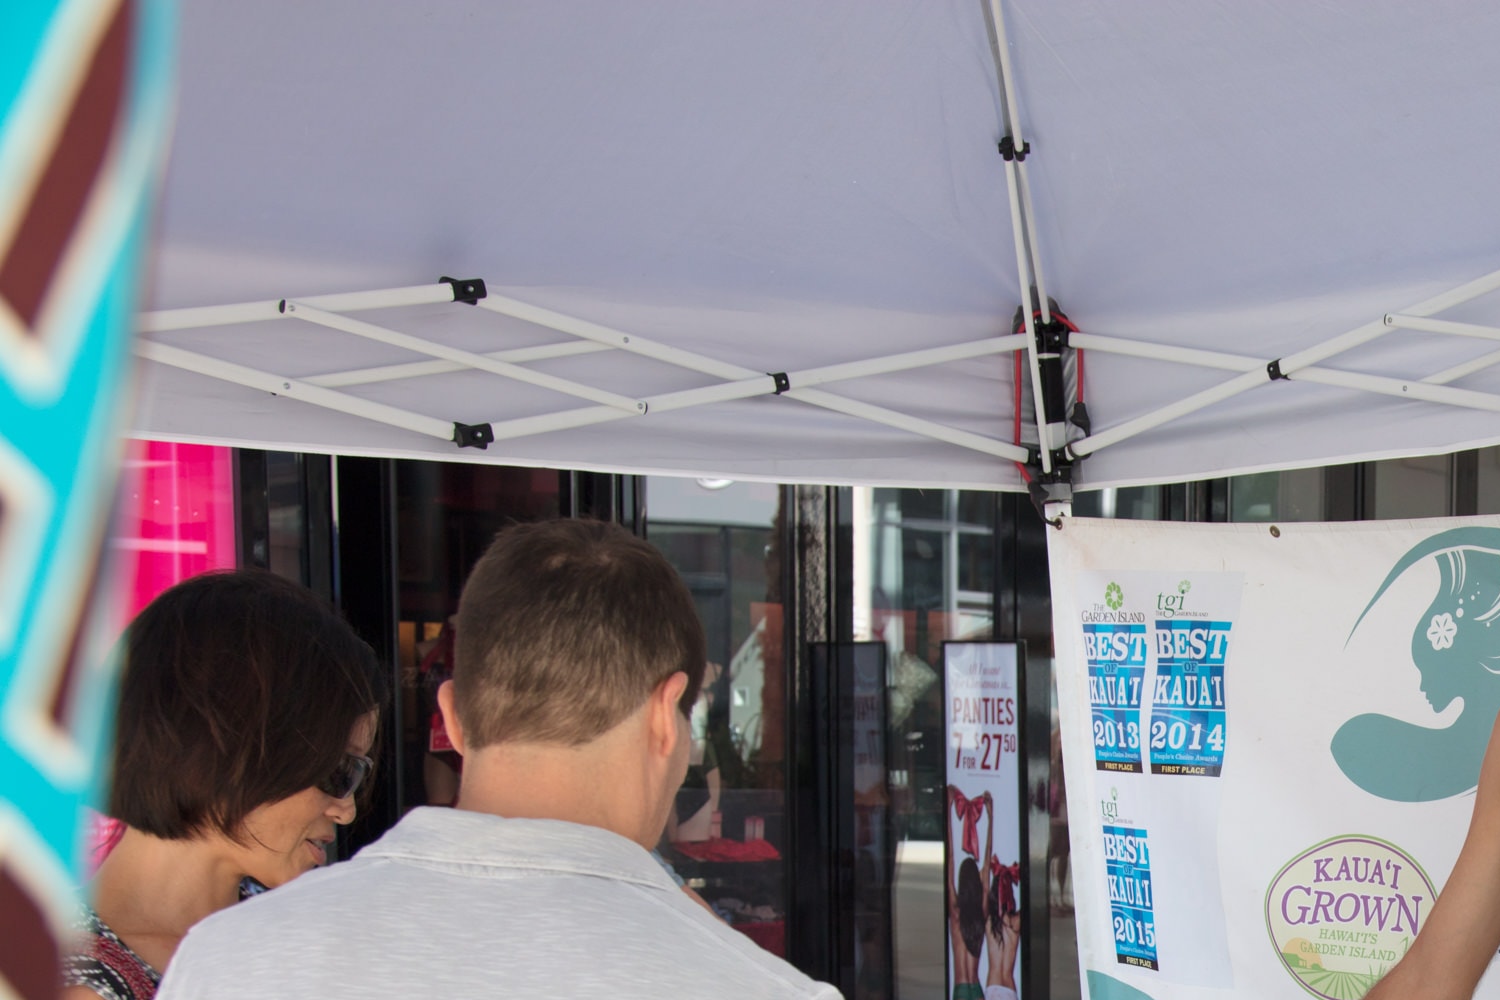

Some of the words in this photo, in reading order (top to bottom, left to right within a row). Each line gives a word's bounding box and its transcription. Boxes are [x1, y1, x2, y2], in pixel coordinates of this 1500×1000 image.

[1081, 610, 1117, 623] GARDEN
[1117, 612, 1145, 623] ISLAND
[1084, 631, 1148, 662] BEST
[1156, 628, 1229, 660] BEST
[1104, 663, 1117, 673] OF
[1184, 662, 1197, 672] OF
[952, 697, 1015, 725] PANTIES
[1094, 720, 1139, 748] 2013
[1151, 720, 1223, 751] 2014
[953, 732, 963, 769] 7
[1105, 762, 1118, 771] FIRST
[1119, 763, 1133, 771] PLACE
[1161, 765, 1180, 773] FIRST
[1181, 766, 1205, 775] PLACE
[1103, 833, 1149, 865] BEST
[1281, 885, 1423, 936] GROWN
[1114, 916, 1155, 947] 2015
[1299, 941, 1347, 957] GARDEN
[1349, 946, 1396, 962] ISLAND
